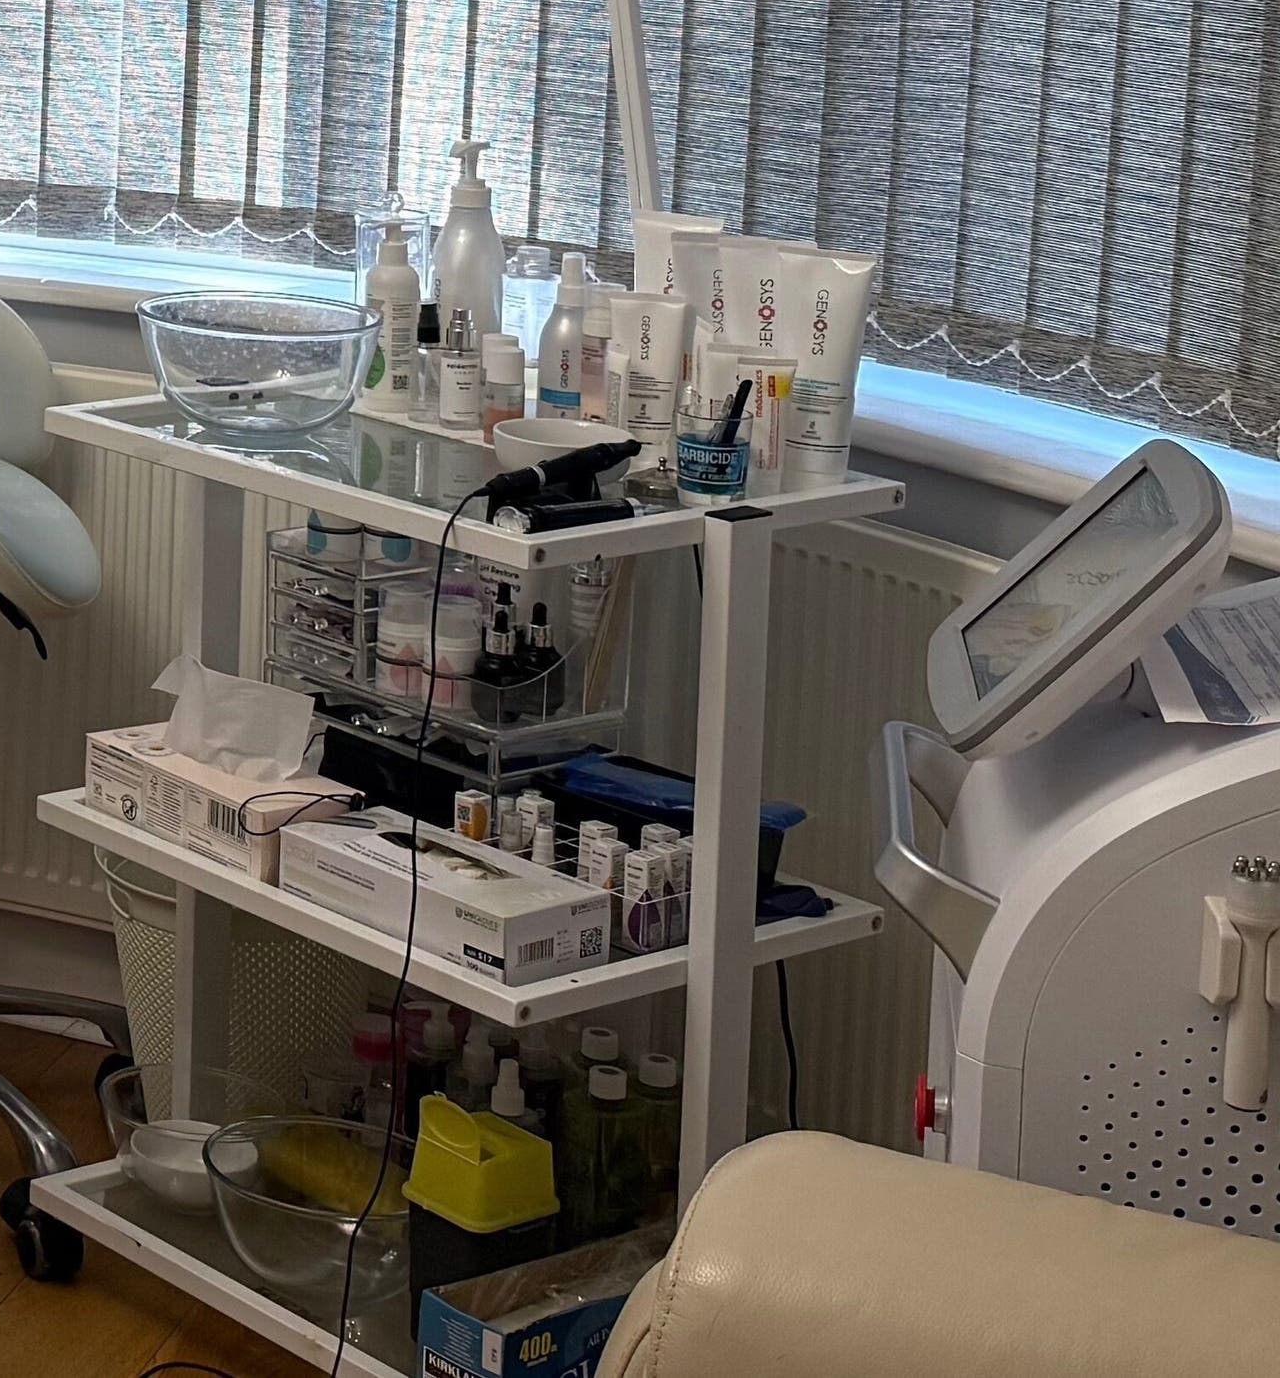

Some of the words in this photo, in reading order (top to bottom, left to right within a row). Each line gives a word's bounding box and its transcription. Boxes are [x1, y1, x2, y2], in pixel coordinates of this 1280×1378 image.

[712, 269, 725, 334] GENOSYS
[811, 289, 830, 356] GENOSYS
[640, 315, 651, 361] GENOSYS
[560, 349, 570, 389] GENOSYS
[428, 1353, 474, 1378] KIRKLA
[519, 1332, 552, 1363] 400
